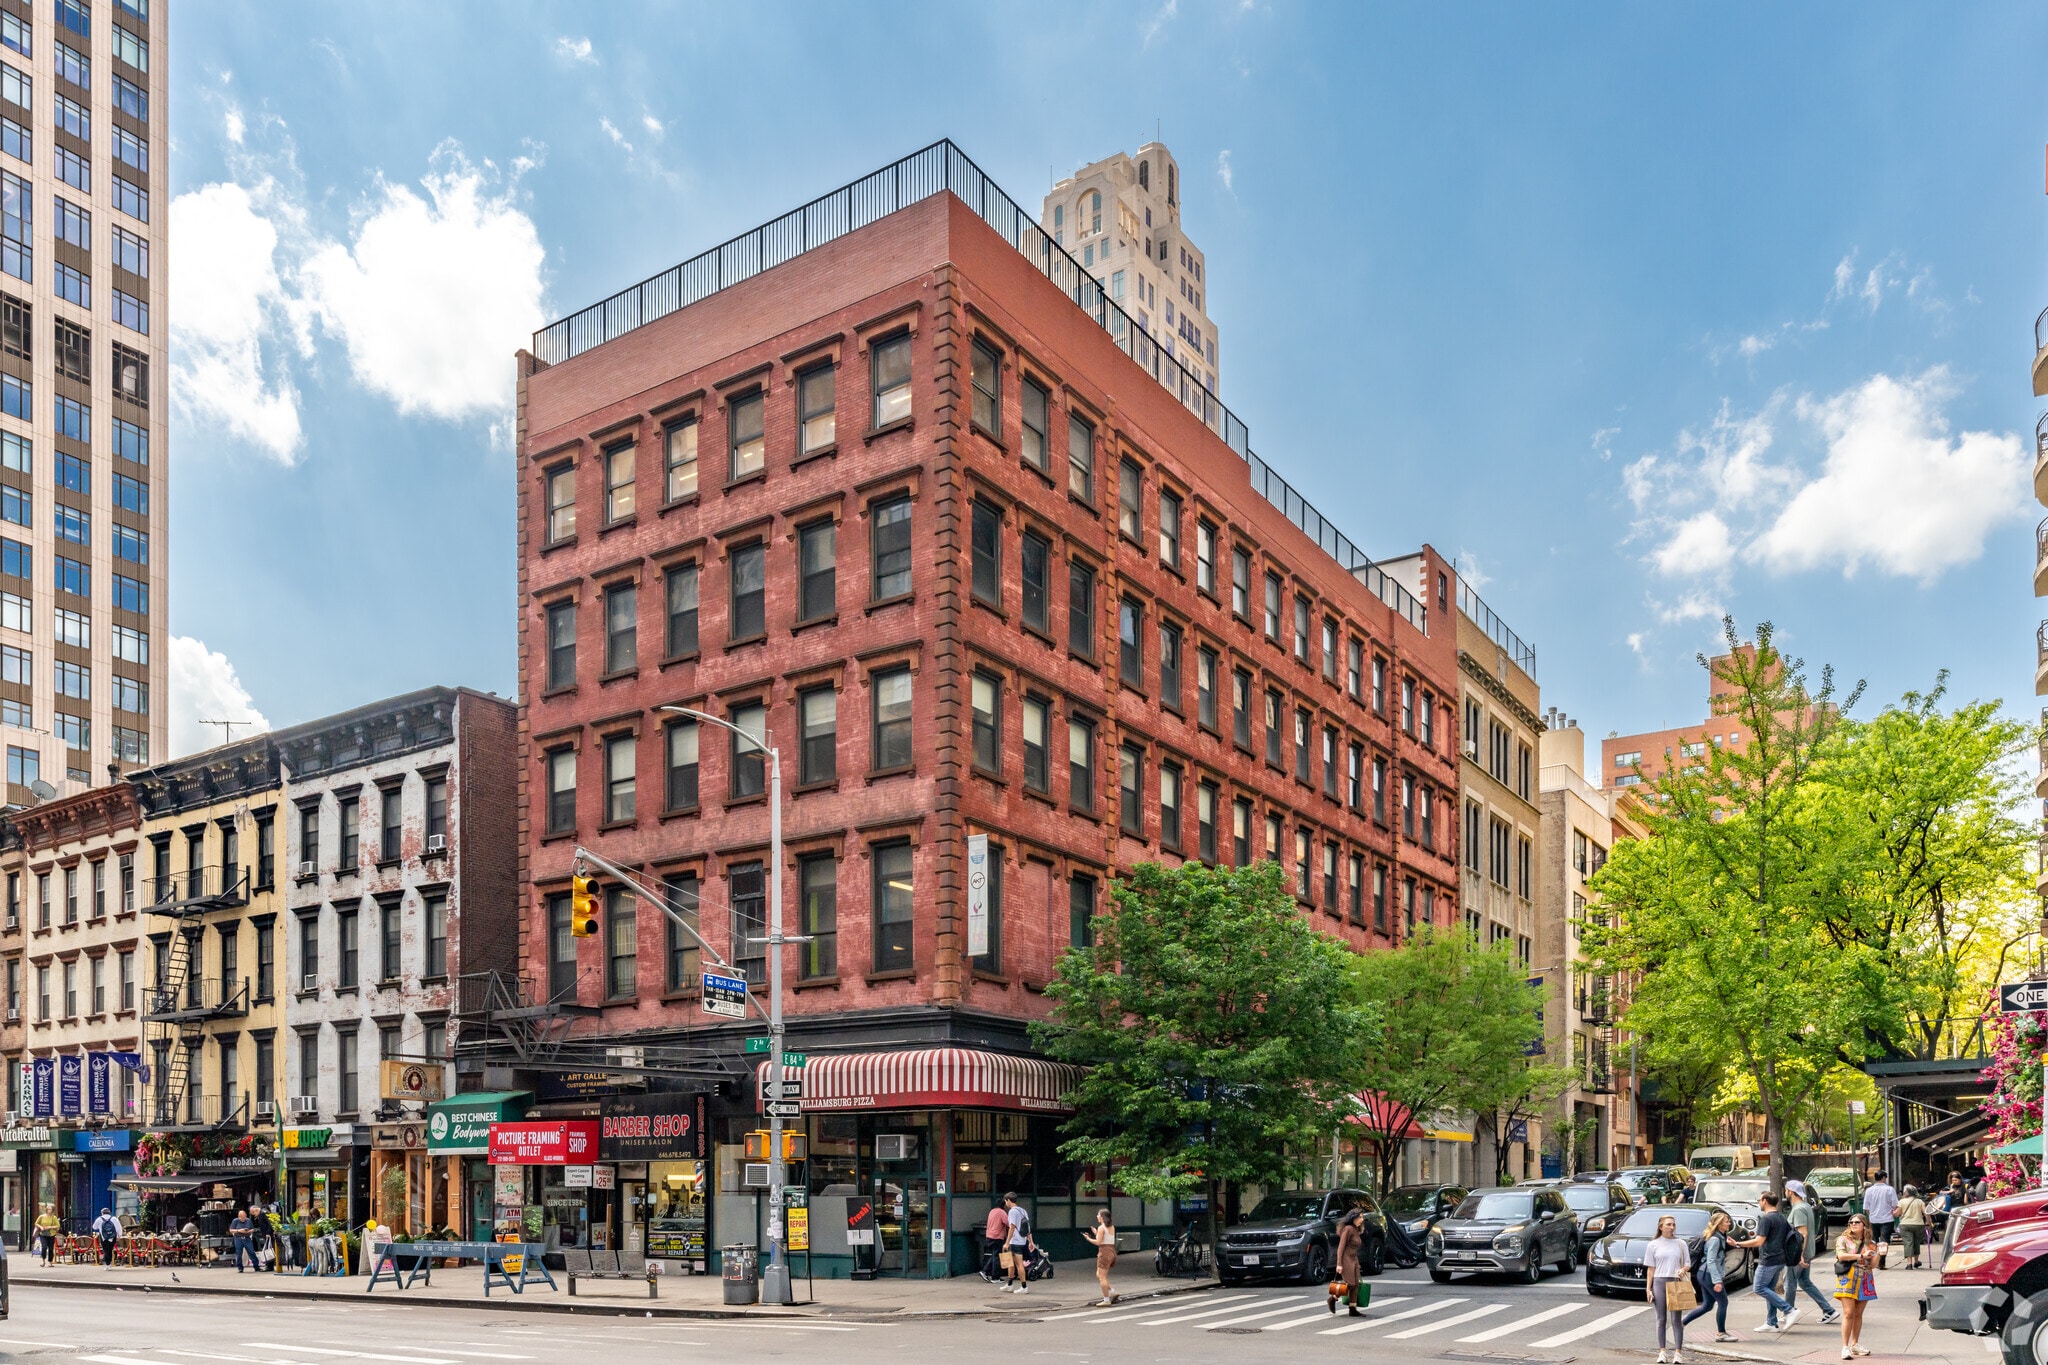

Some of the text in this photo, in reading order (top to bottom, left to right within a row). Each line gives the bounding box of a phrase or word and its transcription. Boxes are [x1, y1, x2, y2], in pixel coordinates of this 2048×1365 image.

[715, 978, 744, 990] BUS LANE
[705, 986, 725, 995] 7AM-10AM
[2016, 990, 2045, 1003] ONE
[717, 1001, 731, 1009] BUSES
[753, 1039, 758, 1051] 2
[784, 1054, 789, 1065] E
[789, 1055, 798, 1066] 84
[567, 1073, 582, 1081] ART
[583, 1072, 607, 1080] GALLE
[22, 1074, 33, 1117] PHARMACY
[853, 1096, 876, 1106] PIZZA
[770, 1105, 797, 1113] ONE WAY
[451, 1111, 498, 1123] BEST CHINESE
[603, 1114, 690, 1138] BARBER SHOP
[452, 1124, 490, 1143] Bodywor
[497, 1131, 560, 1145] PICTURE FRAMING
[88, 1139, 115, 1148] CALEDONIA
[568, 1137, 587, 1153] SHOP
[648, 1138, 673, 1146] SALON
[518, 1145, 542, 1157] OUTLET
[203, 1158, 226, 1167] Ramen
[226, 1156, 232, 1166] &
[232, 1156, 256, 1166] Robata
[595, 1169, 613, 1177] HAIRCUT
[938, 1183, 945, 1191] A
[547, 1199, 568, 1207] SINCE
[506, 1209, 521, 1217] ATM
[848, 1202, 872, 1226] Fresh!
[789, 1220, 807, 1228] REPAIR
